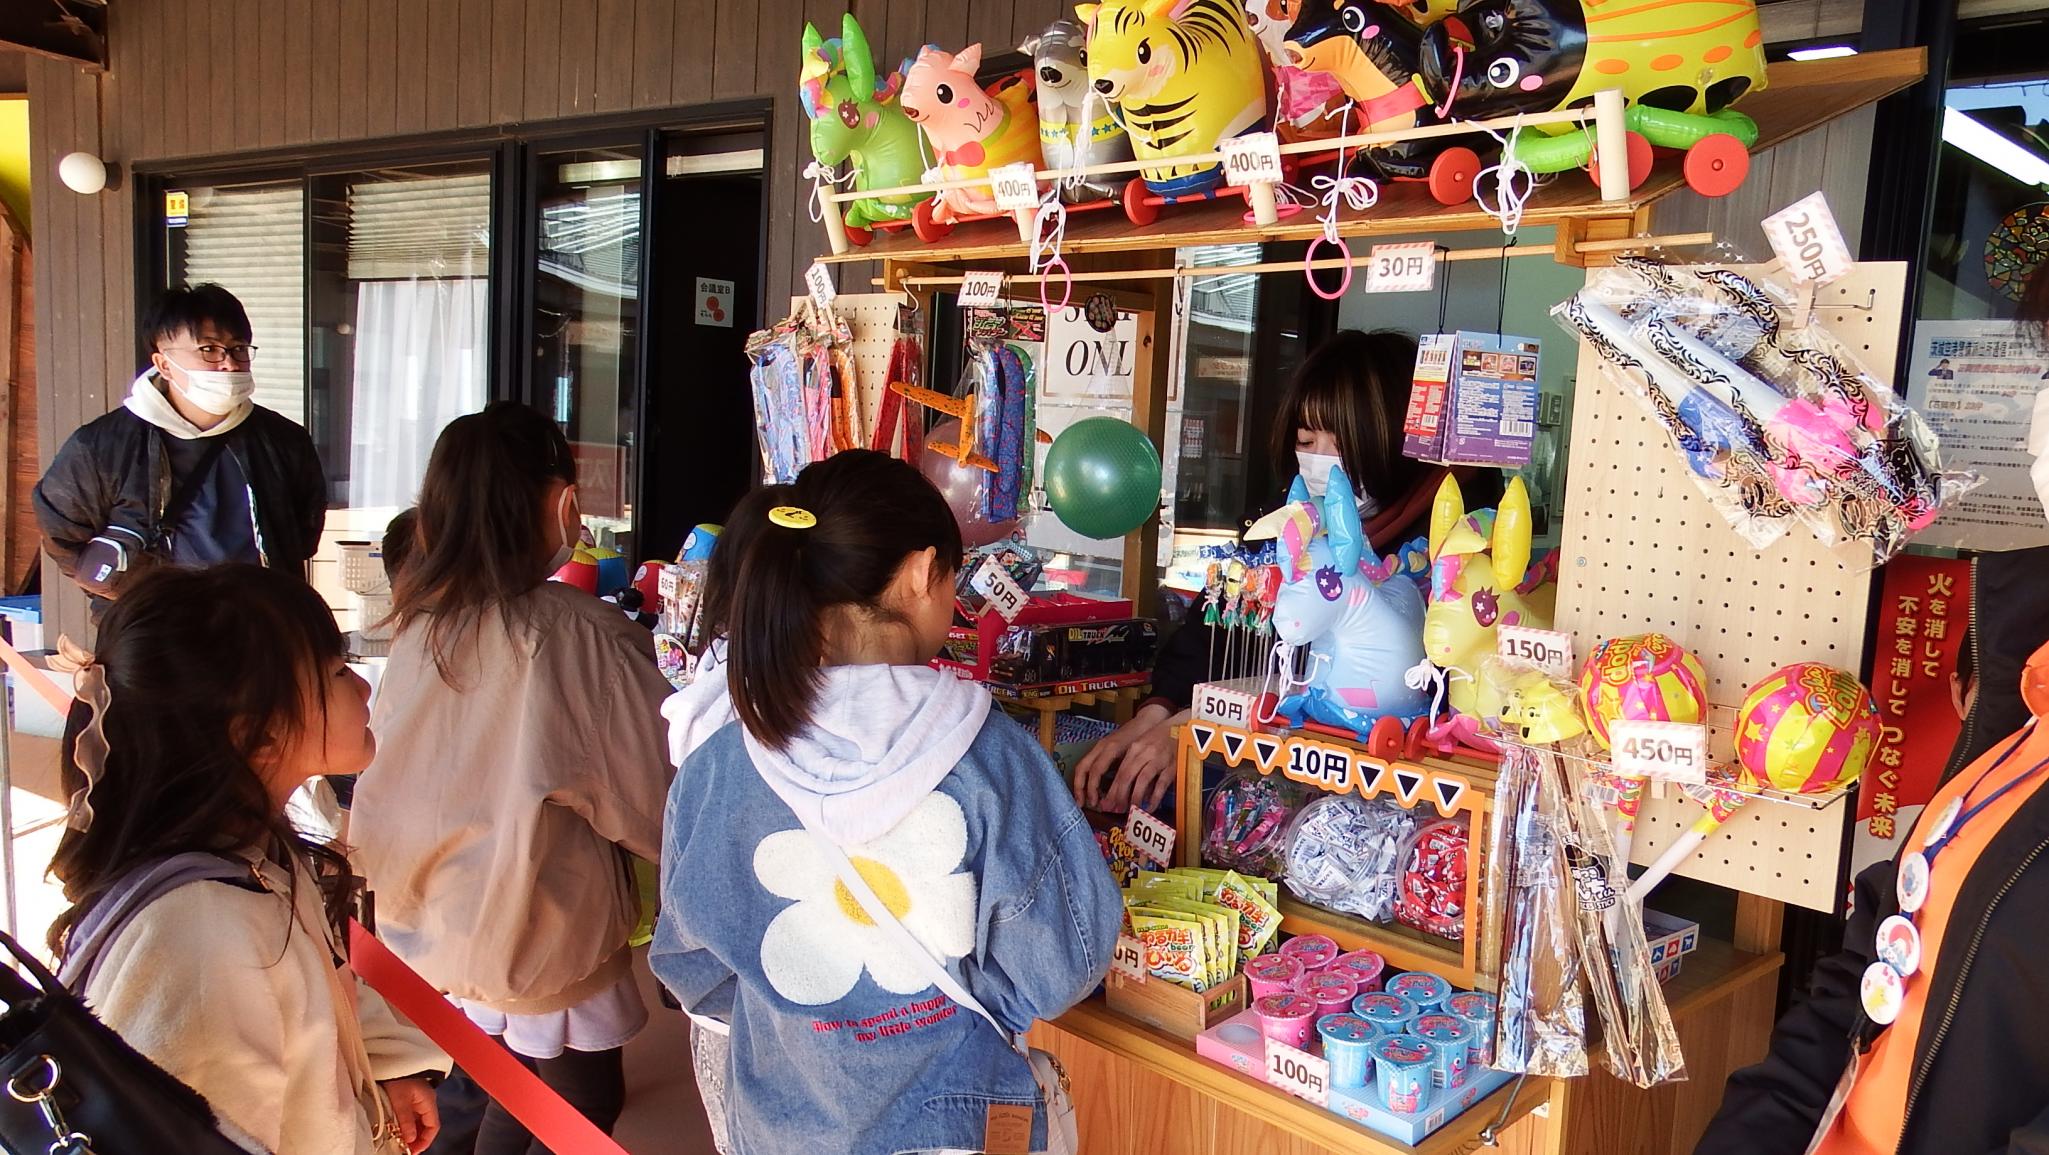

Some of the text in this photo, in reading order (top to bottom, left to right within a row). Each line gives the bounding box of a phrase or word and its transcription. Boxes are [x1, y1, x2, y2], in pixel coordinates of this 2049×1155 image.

[1230, 151, 1274, 172] 400円
[998, 179, 1031, 197] 400円
[1784, 211, 1827, 280] 250円
[1379, 256, 1423, 277] 30円
[811, 267, 827, 305] 100円
[965, 281, 996, 298] 100円
[1065, 339, 1132, 377] ONL
[984, 572, 1018, 610] 50円
[1922, 573, 1953, 677] 火を消して
[1507, 638, 1563, 666] 150円
[1058, 685, 1079, 695] OIL
[1081, 680, 1118, 692] TRUCK
[1204, 696, 1243, 721] 50円
[1869, 595, 1920, 840] 不安を消して つなぐ未来
[1289, 746, 1349, 785] 10円
[1622, 737, 1693, 766] 450円
[1132, 819, 1167, 853] 60円
[1113, 946, 1139, 969] 0円
[855, 1004, 958, 1043] my little wonder
[860, 1007, 898, 1029] spend
[900, 1006, 909, 1017] a
[910, 994, 947, 1015] happy
[1272, 1053, 1323, 1094] 100円
